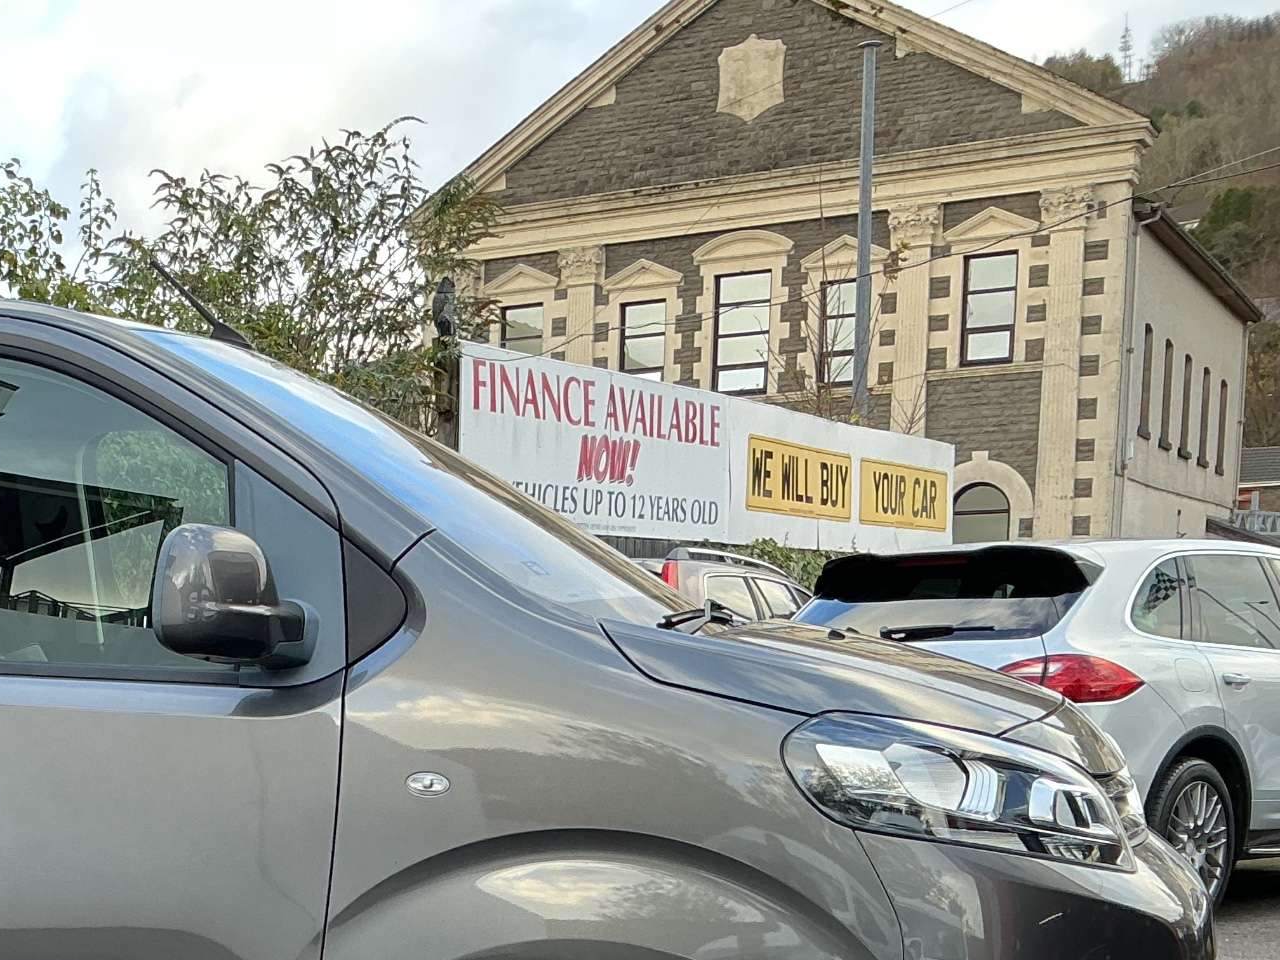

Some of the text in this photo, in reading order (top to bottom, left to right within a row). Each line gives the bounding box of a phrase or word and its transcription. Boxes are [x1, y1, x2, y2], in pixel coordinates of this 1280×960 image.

[472, 358, 721, 447] FINANCE AVAILABLE
[576, 434, 641, 487] NOW!
[751, 447, 848, 508] WE WILL BUY
[583, 487, 603, 516] UP
[607, 490, 626, 518] TO
[631, 494, 645, 520] 12
[649, 495, 687, 523] YEARS
[690, 499, 719, 525] OLD
[873, 471, 937, 520] YOUR CAR
